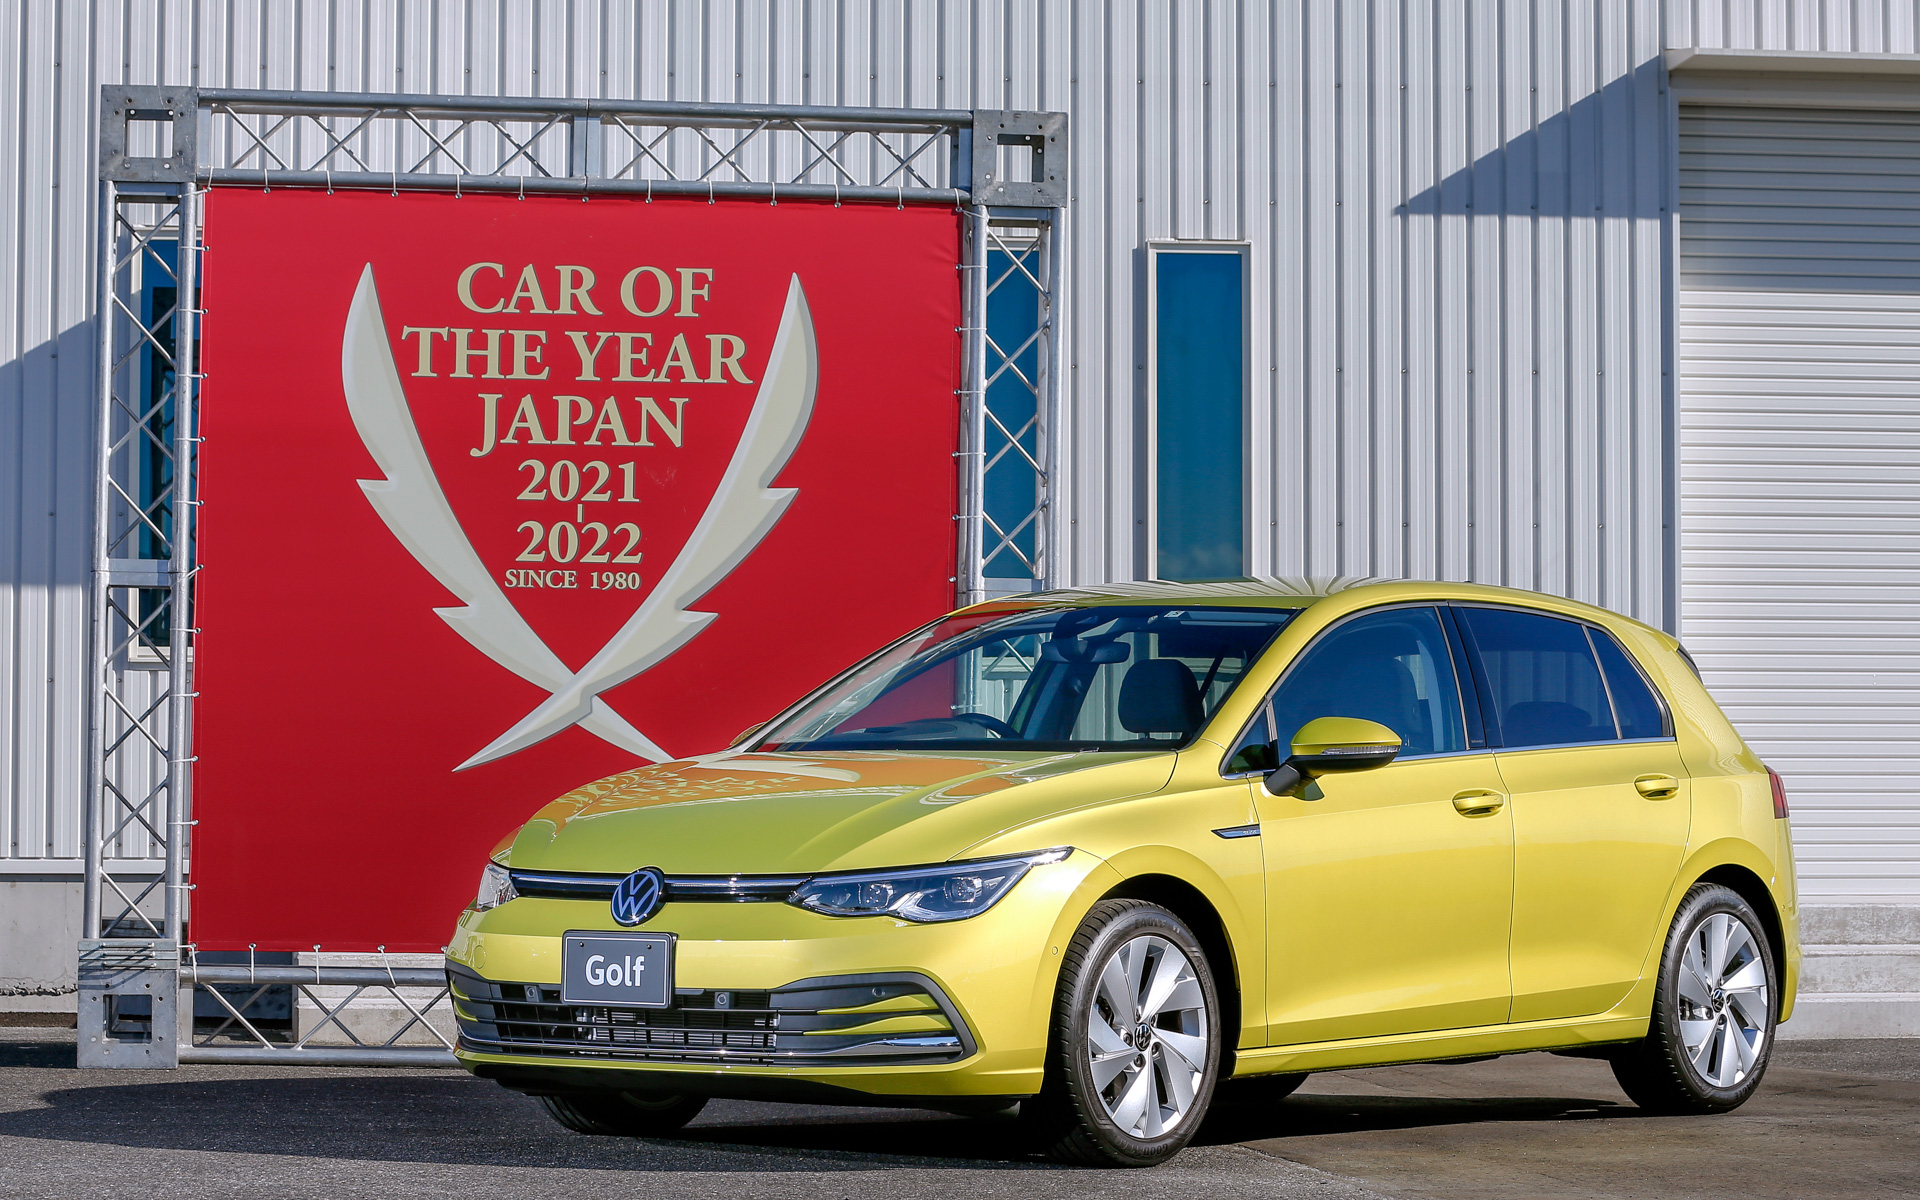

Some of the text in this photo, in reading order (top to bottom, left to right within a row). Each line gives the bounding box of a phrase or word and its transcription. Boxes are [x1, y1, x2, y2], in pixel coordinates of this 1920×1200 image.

[457, 262, 714, 318] CAR OF
[401, 325, 754, 384] THE YEAR
[470, 393, 690, 457] JAPAN
[517, 459, 640, 502] 2021
[515, 520, 643, 564] 2022
[504, 568, 641, 590] SINCE 1980
[585, 954, 645, 987] Golf
